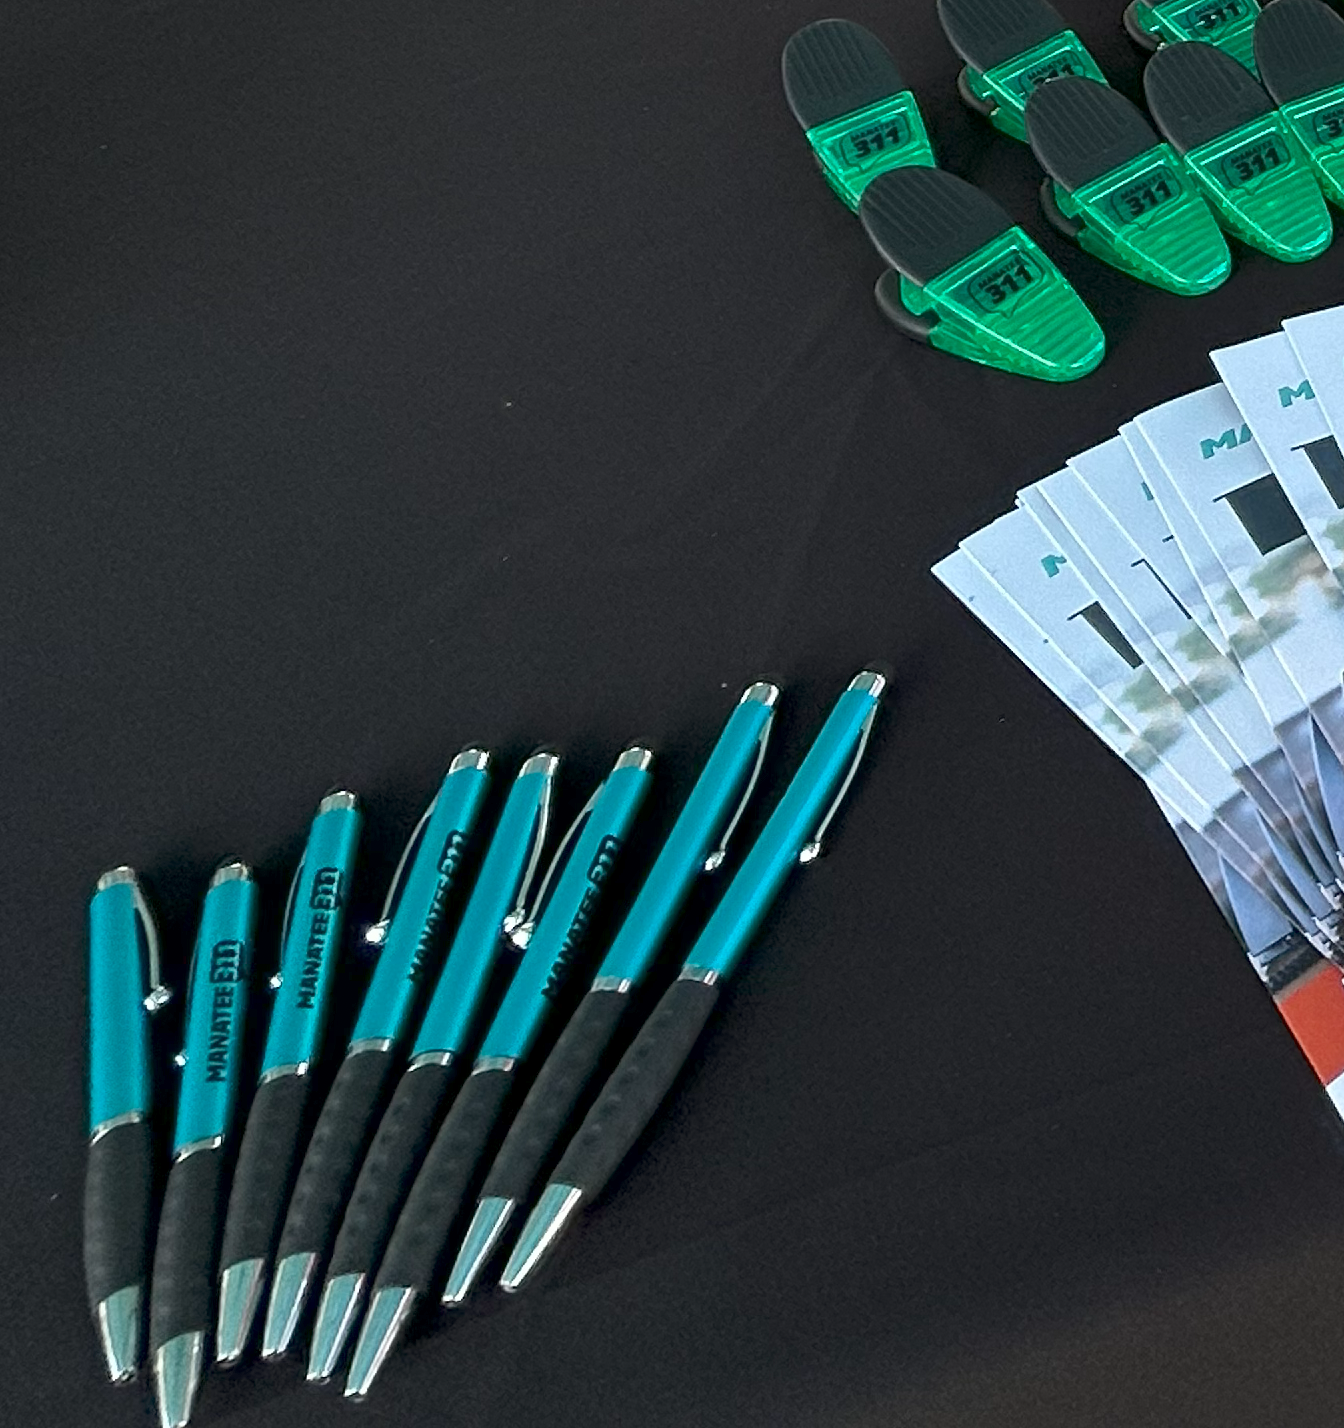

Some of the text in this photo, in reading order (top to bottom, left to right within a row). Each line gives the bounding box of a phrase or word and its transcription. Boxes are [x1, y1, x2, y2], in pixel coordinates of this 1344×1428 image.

[853, 127, 900, 159] 311
[1236, 148, 1280, 181] 311
[1125, 181, 1172, 217] 311
[984, 264, 1032, 305] 311
[215, 943, 239, 981] 311
[297, 911, 332, 1009] MANATEE
[206, 983, 235, 1084] MANATEE
